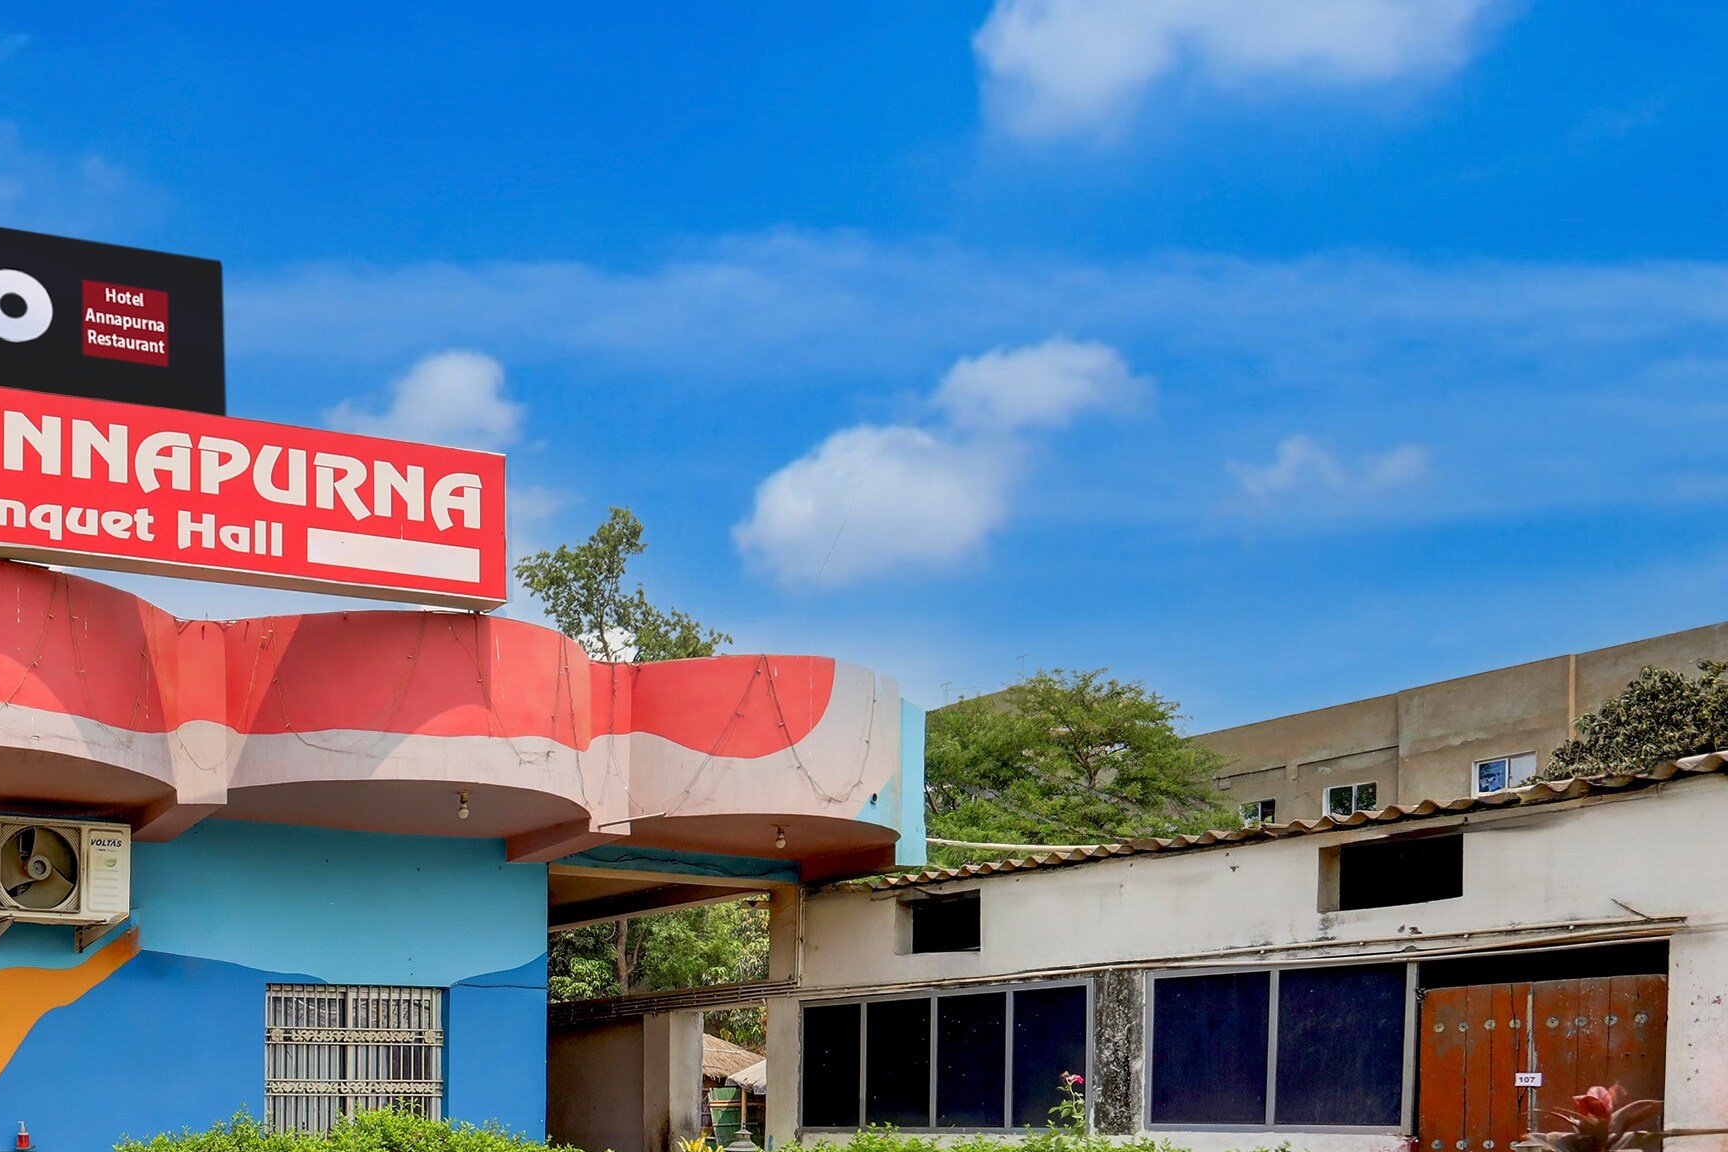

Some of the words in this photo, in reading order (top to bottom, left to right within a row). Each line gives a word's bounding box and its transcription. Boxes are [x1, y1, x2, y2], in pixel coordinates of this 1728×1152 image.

[105, 287, 144, 307] Hotel
[85, 307, 165, 332] Annapurna
[87, 329, 165, 354] Restaurant
[177, 509, 284, 557] Hall
[90, 838, 123, 848] VOLTAS
[1519, 1076, 1536, 1084] 107
